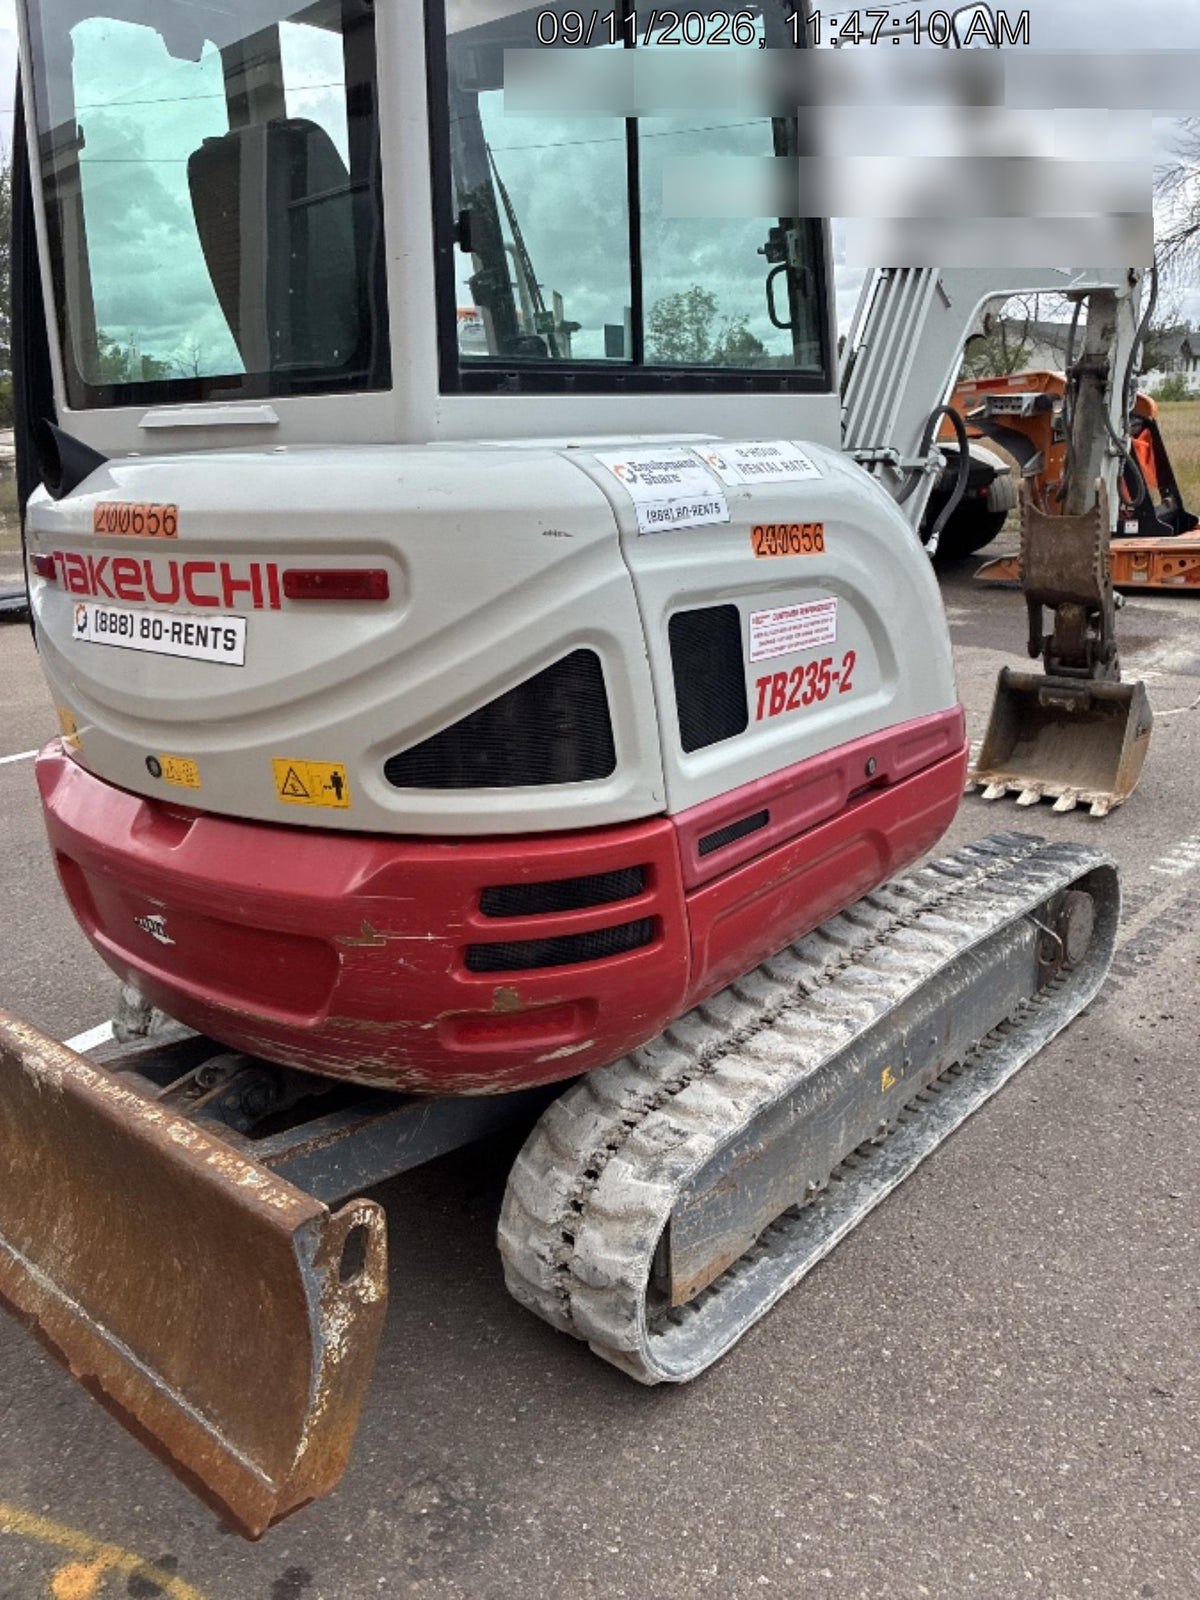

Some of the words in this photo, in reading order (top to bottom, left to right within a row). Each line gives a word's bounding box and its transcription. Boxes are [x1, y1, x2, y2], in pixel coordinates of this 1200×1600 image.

[627, 458, 701, 475] Equipment
[641, 472, 682, 485] Share
[737, 461, 783, 475] RENTAL
[780, 458, 811, 472] RATE
[95, 503, 177, 537] 200656
[754, 523, 823, 555] 200656
[95, 610, 134, 638] (888)
[140, 618, 237, 651] 80-RENTS
[755, 649, 857, 722] TB235-2
